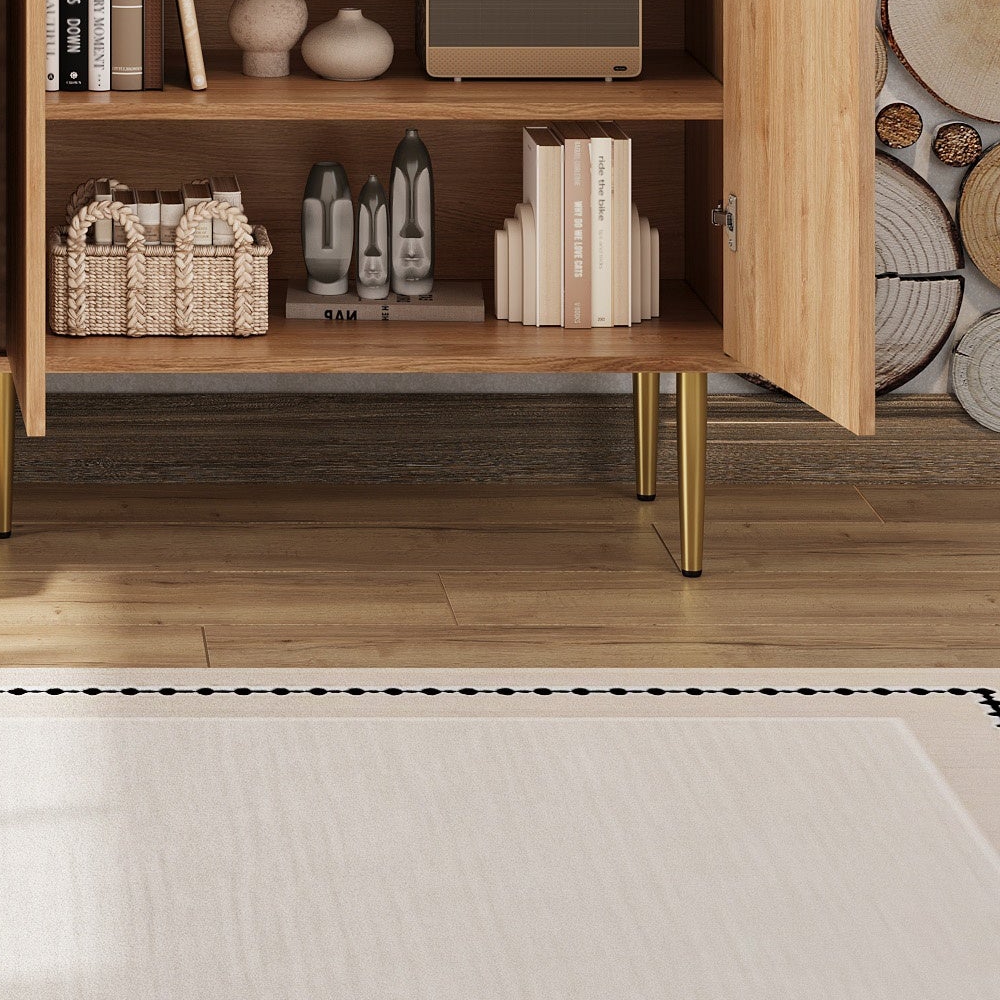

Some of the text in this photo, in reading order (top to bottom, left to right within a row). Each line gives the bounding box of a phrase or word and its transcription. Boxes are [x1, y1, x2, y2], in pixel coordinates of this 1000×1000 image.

[67, 18, 81, 53] DOWN
[93, 17, 104, 70] MOMENT
[598, 156, 606, 222] ride the bike
